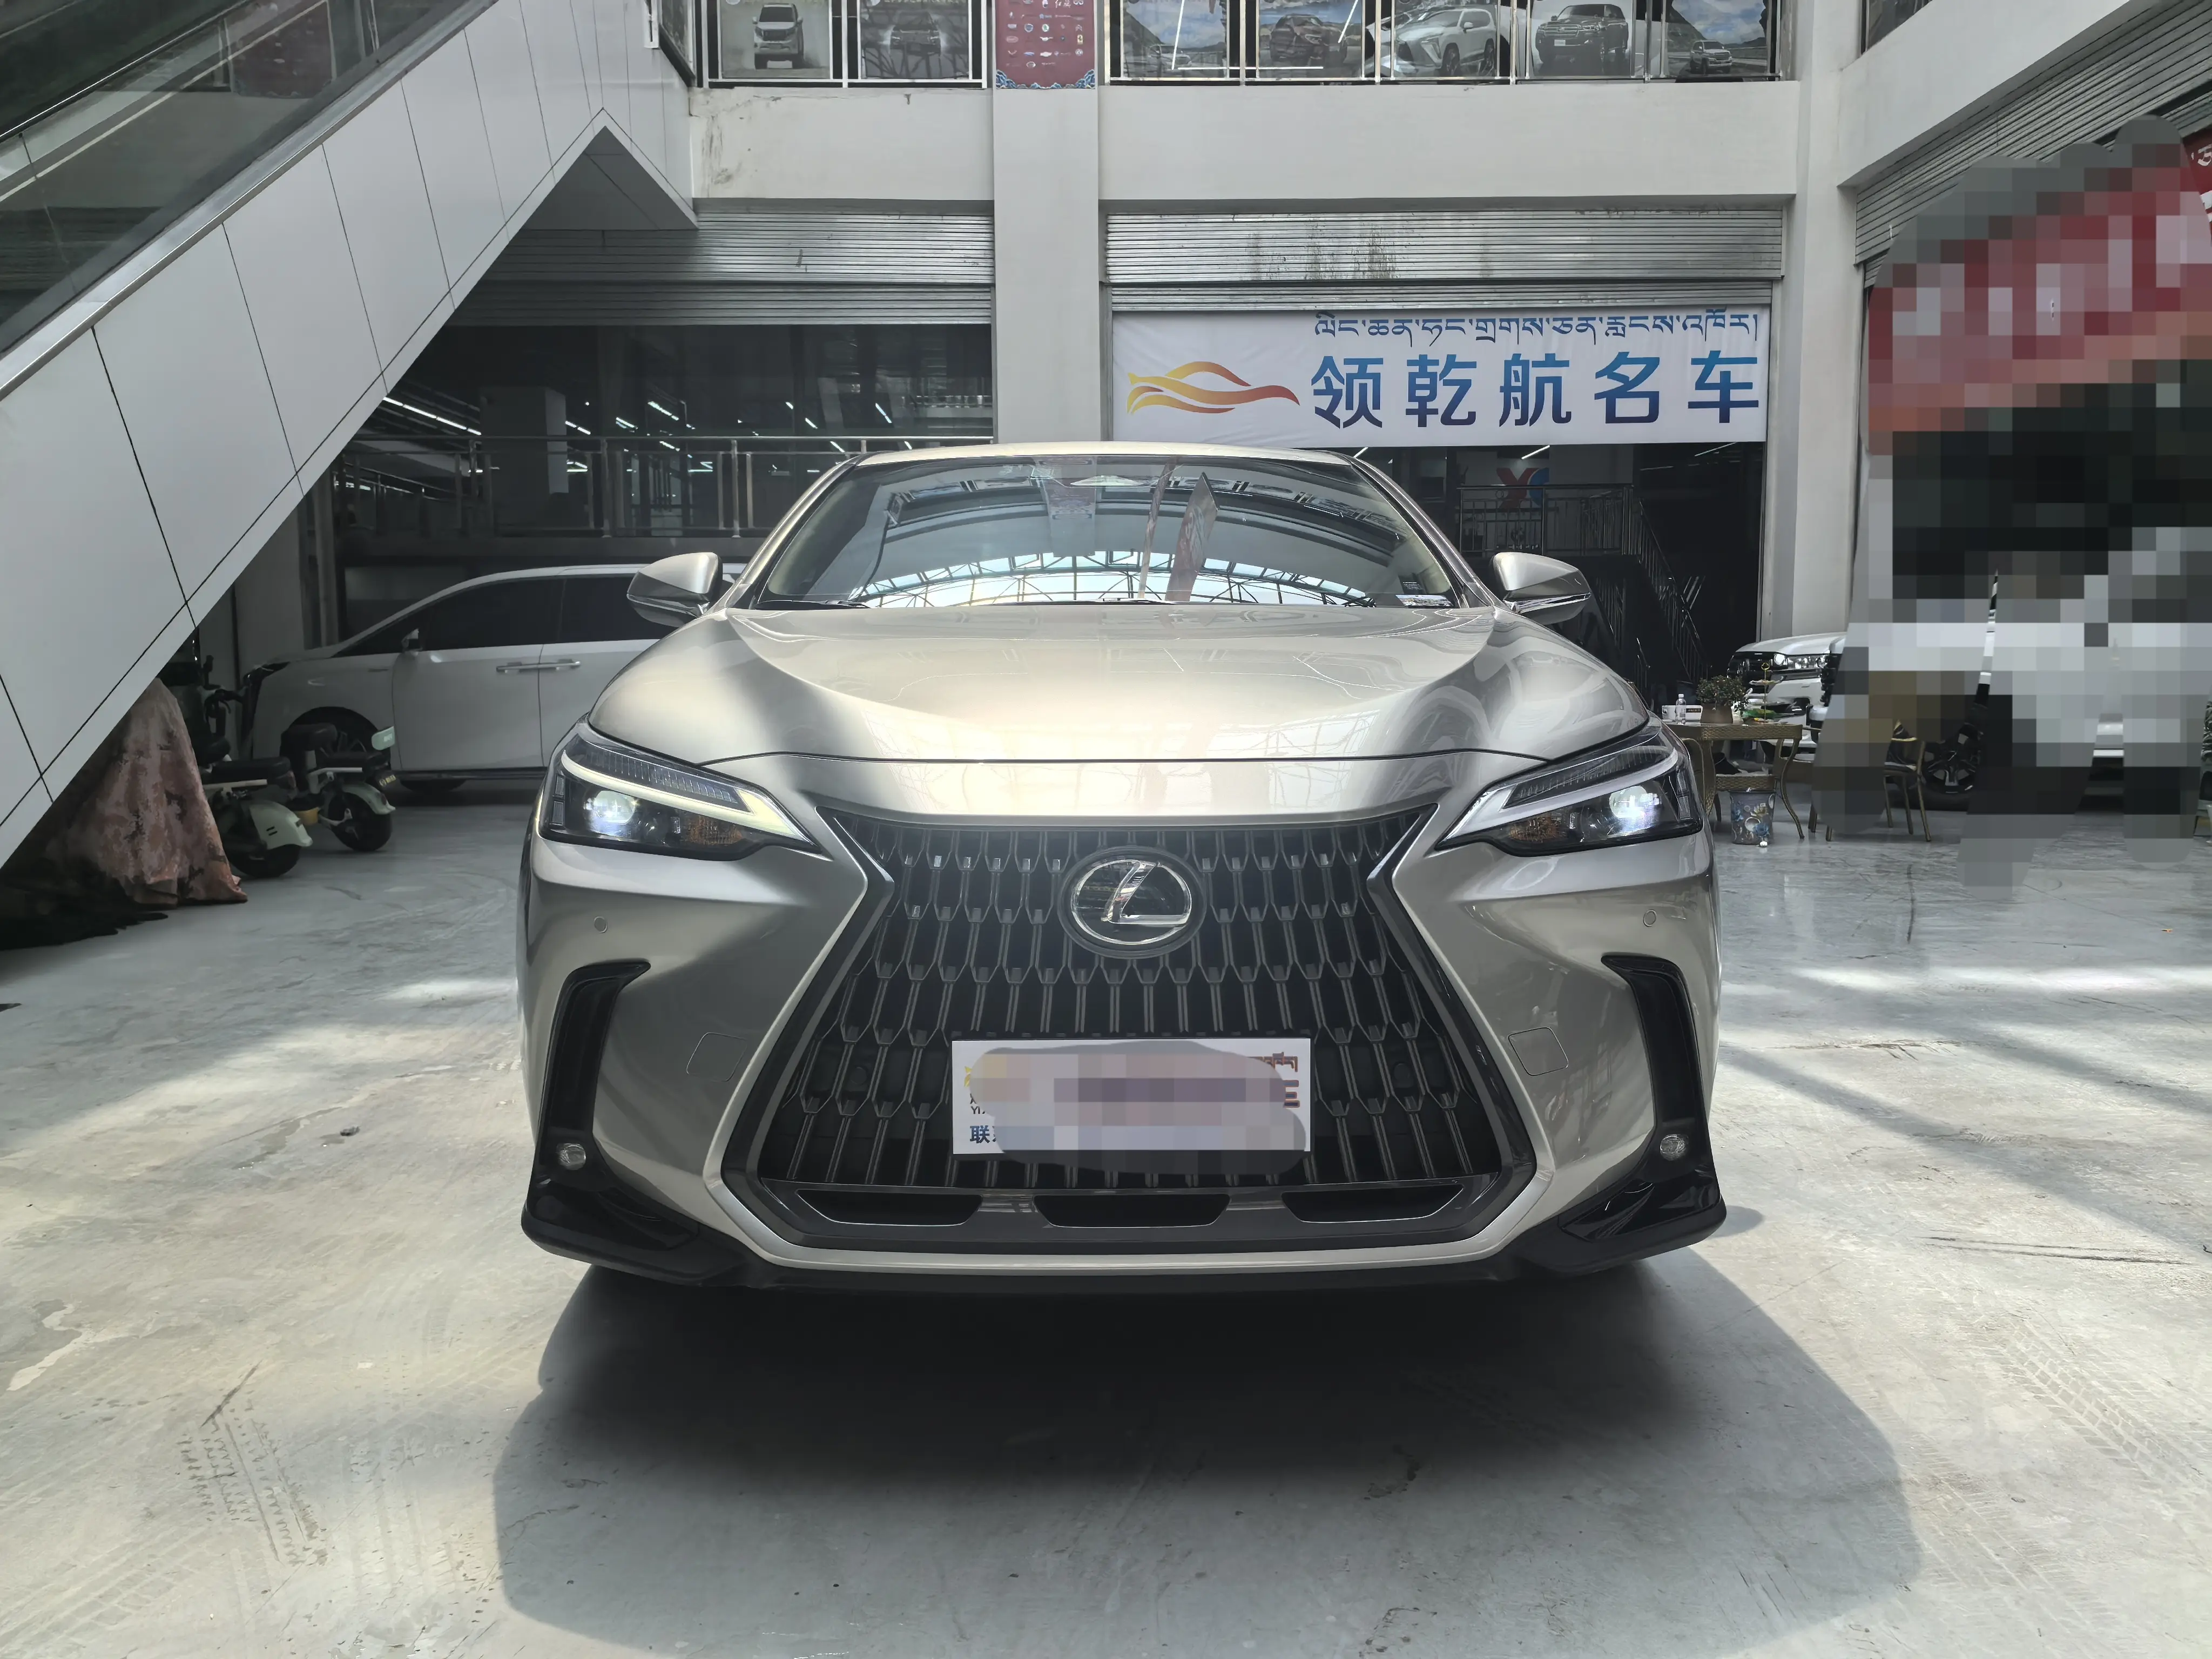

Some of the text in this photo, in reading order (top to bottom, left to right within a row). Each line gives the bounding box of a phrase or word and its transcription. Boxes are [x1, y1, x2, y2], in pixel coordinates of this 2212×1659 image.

[1311, 350, 1759, 429] 领乾航名车
